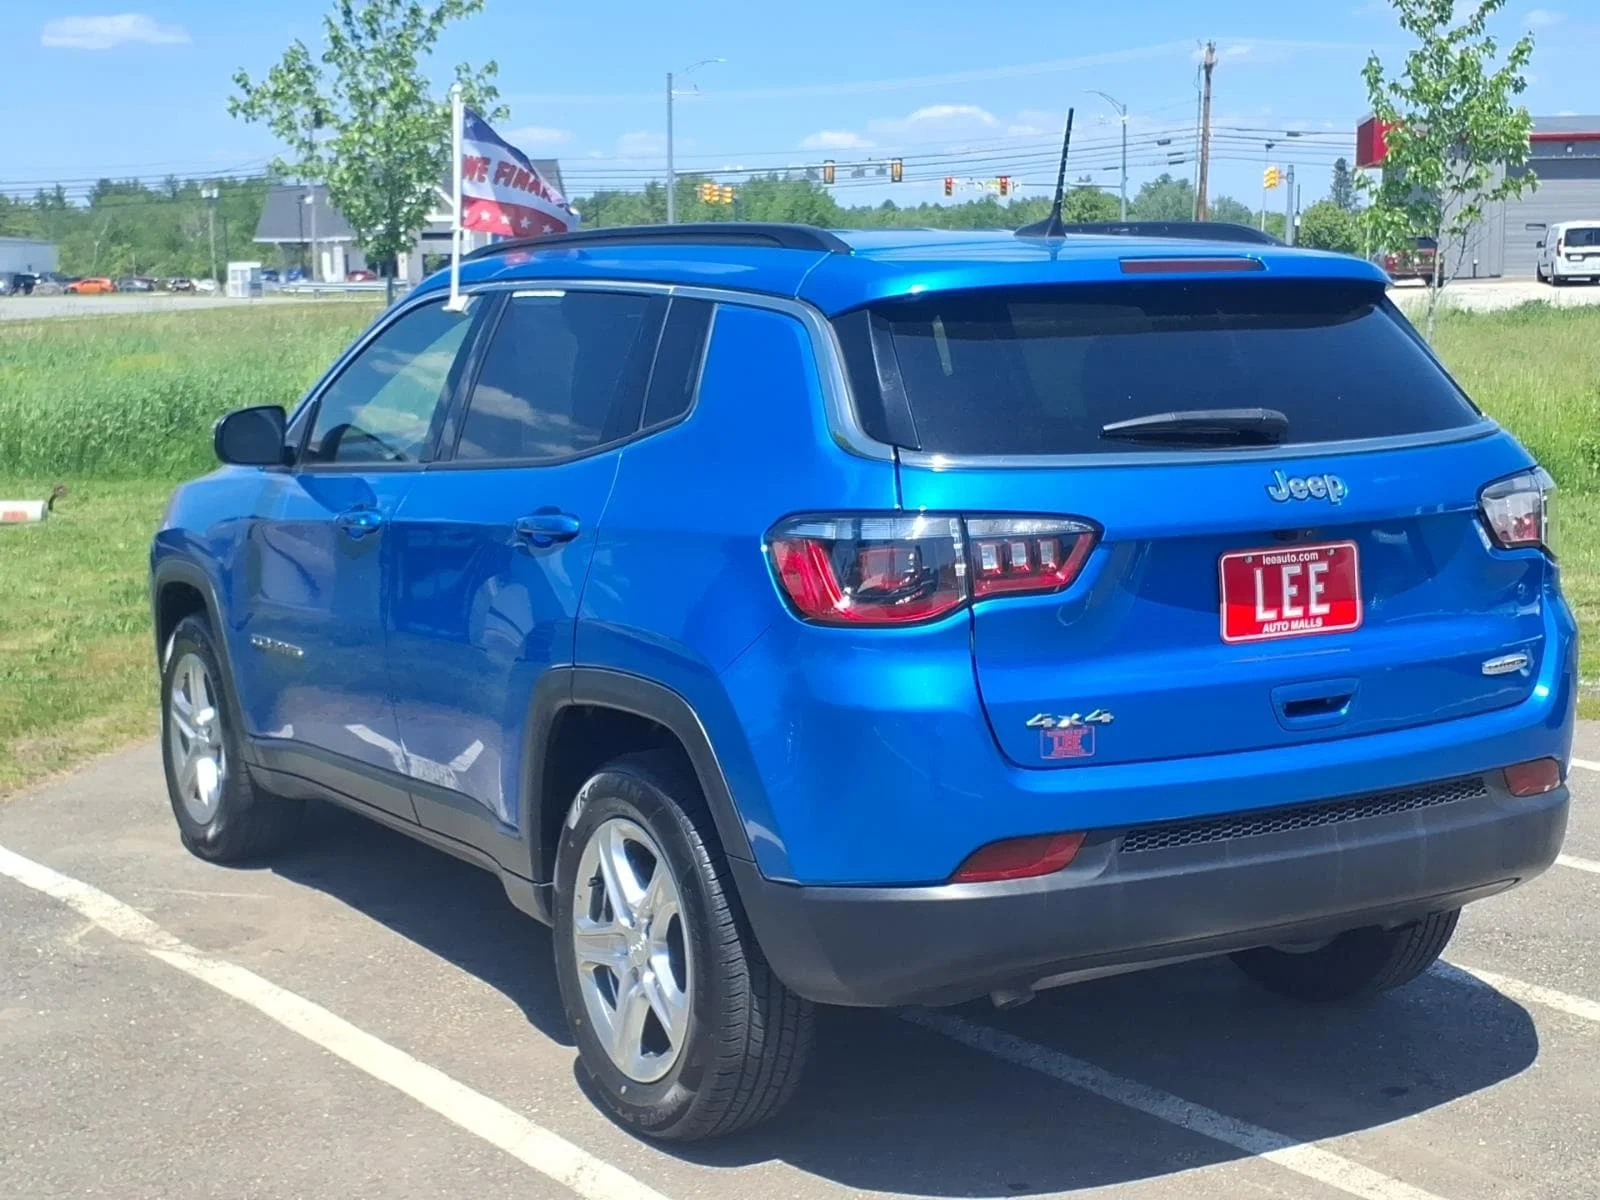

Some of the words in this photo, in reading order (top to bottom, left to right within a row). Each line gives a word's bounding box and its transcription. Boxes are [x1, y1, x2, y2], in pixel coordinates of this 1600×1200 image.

[1266, 469, 1347, 504] Jeep
[1262, 551, 1319, 565] leeauto.com
[1254, 561, 1331, 622] LEE
[1262, 621, 1289, 634] AUTO
[1290, 617, 1323, 631] MALLS
